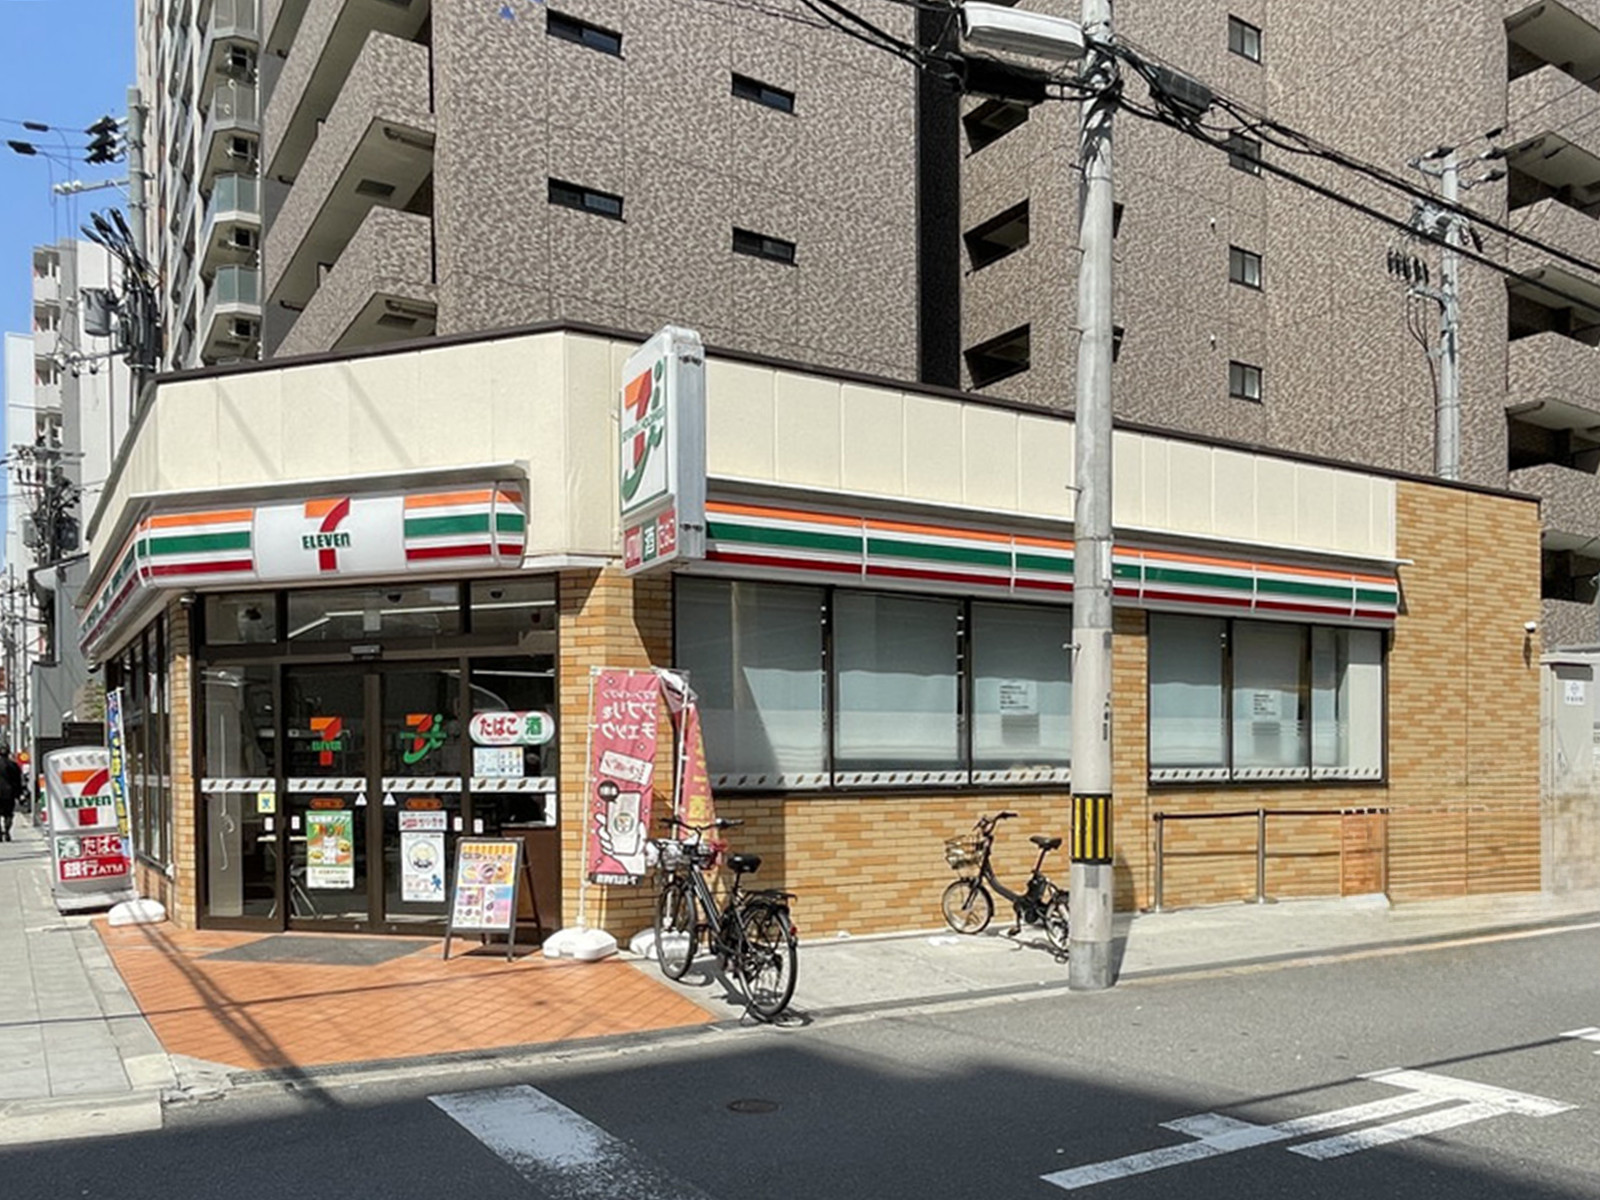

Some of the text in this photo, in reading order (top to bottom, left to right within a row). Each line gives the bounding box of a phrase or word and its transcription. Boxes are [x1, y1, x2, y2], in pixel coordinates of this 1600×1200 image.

[480, 715, 542, 736] たばこ 酒
[59, 837, 121, 859] 酒 たばこ
